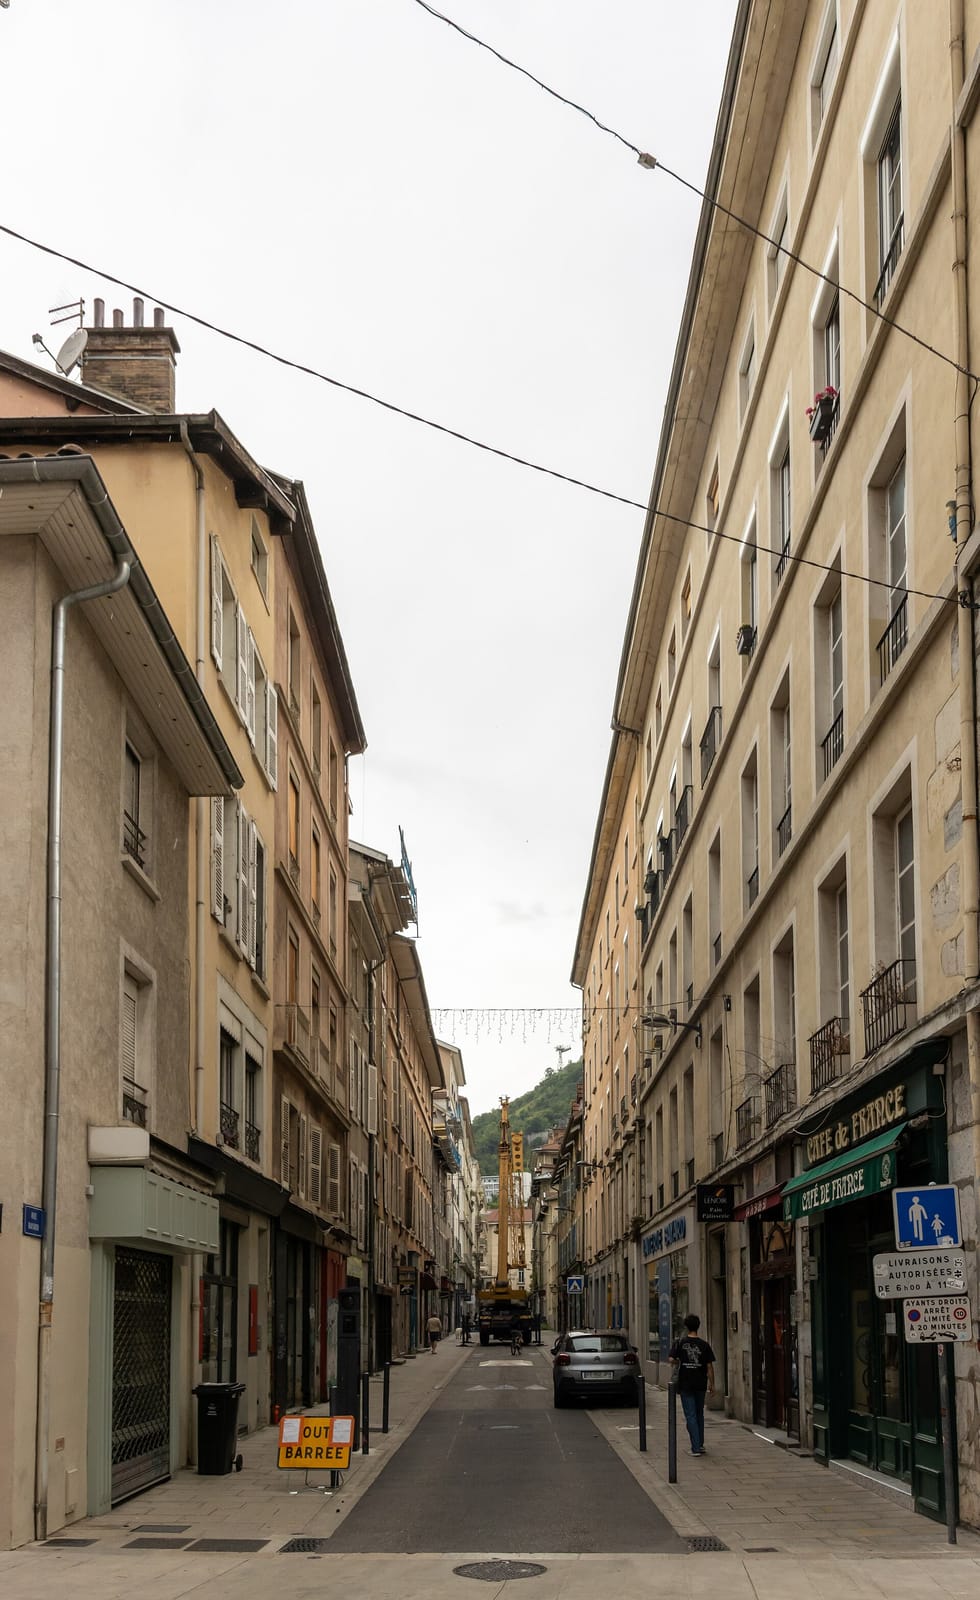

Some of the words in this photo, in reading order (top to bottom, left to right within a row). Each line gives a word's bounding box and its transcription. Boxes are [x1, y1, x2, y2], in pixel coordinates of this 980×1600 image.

[834, 1121, 849, 1150] de
[851, 1085, 907, 1142] FRANCE
[801, 1183, 820, 1211] CAFÉ
[820, 1183, 831, 1206] DE
[831, 1168, 865, 1201] FRANCE
[888, 1255, 950, 1267] LIVRAISONS
[888, 1268, 952, 1280] AUTORISÉES
[878, 1284, 891, 1293] DE
[896, 1283, 921, 1292] 6h00
[926, 1281, 932, 1290] À
[905, 1299, 936, 1307] AYANTS
[938, 1298, 968, 1306] DROITS
[924, 1306, 950, 1314] ARRÊT
[924, 1314, 952, 1322] LIMITÉ
[910, 1323, 915, 1331] À
[930, 1322, 967, 1330] MINUTES
[303, 1426, 330, 1439] OUT
[285, 1446, 343, 1459] BARREE
